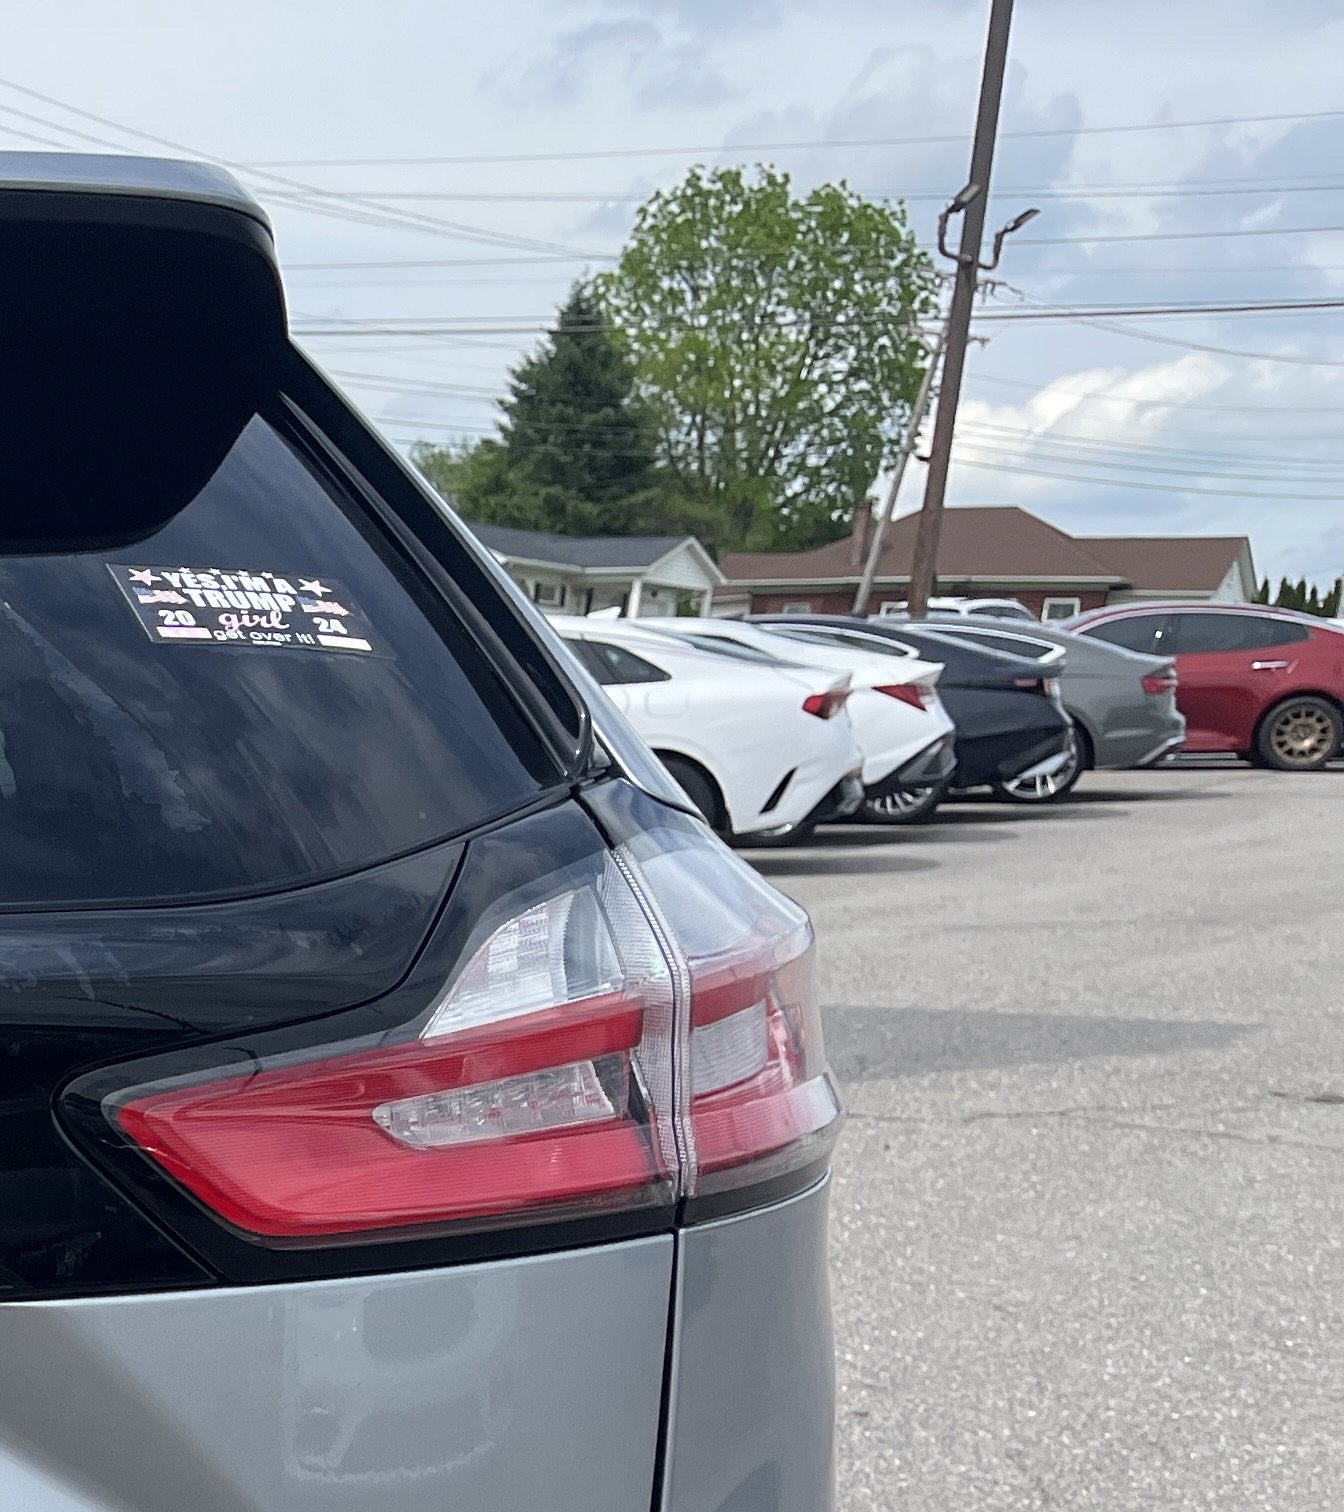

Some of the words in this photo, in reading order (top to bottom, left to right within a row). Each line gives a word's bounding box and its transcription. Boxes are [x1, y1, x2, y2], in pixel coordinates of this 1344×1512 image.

[272, 578, 297, 595] A
[182, 588, 296, 613] TRUMP
[158, 610, 197, 627] 20
[217, 609, 291, 633] girl
[313, 616, 348, 635] 24
[249, 631, 292, 643] over
